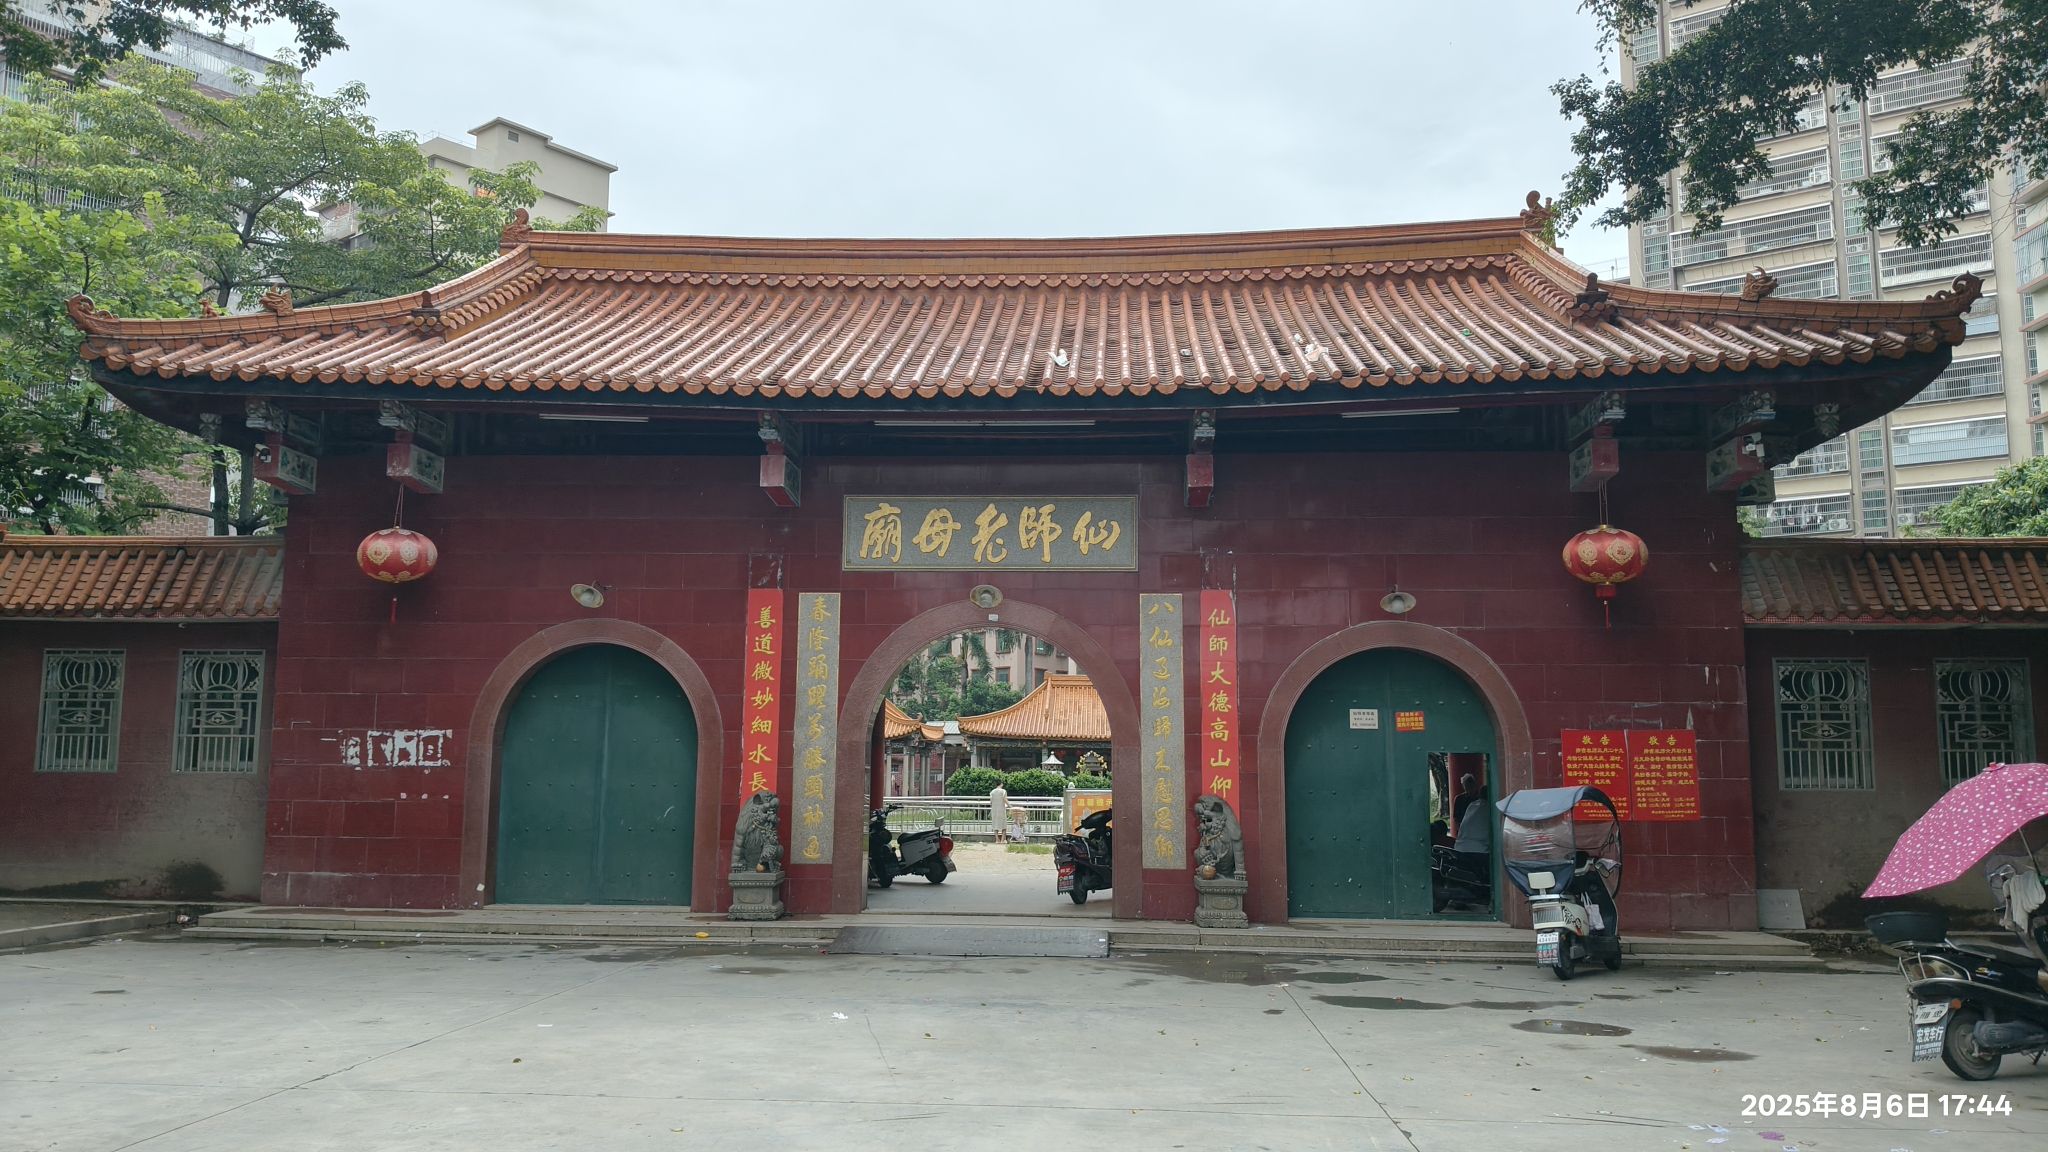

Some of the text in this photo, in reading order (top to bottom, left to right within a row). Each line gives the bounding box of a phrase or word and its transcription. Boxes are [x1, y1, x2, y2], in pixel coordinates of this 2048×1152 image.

[748, 606, 776, 791] 善道微妙細水長
[1208, 608, 1232, 798] 仙師大德高山仰
